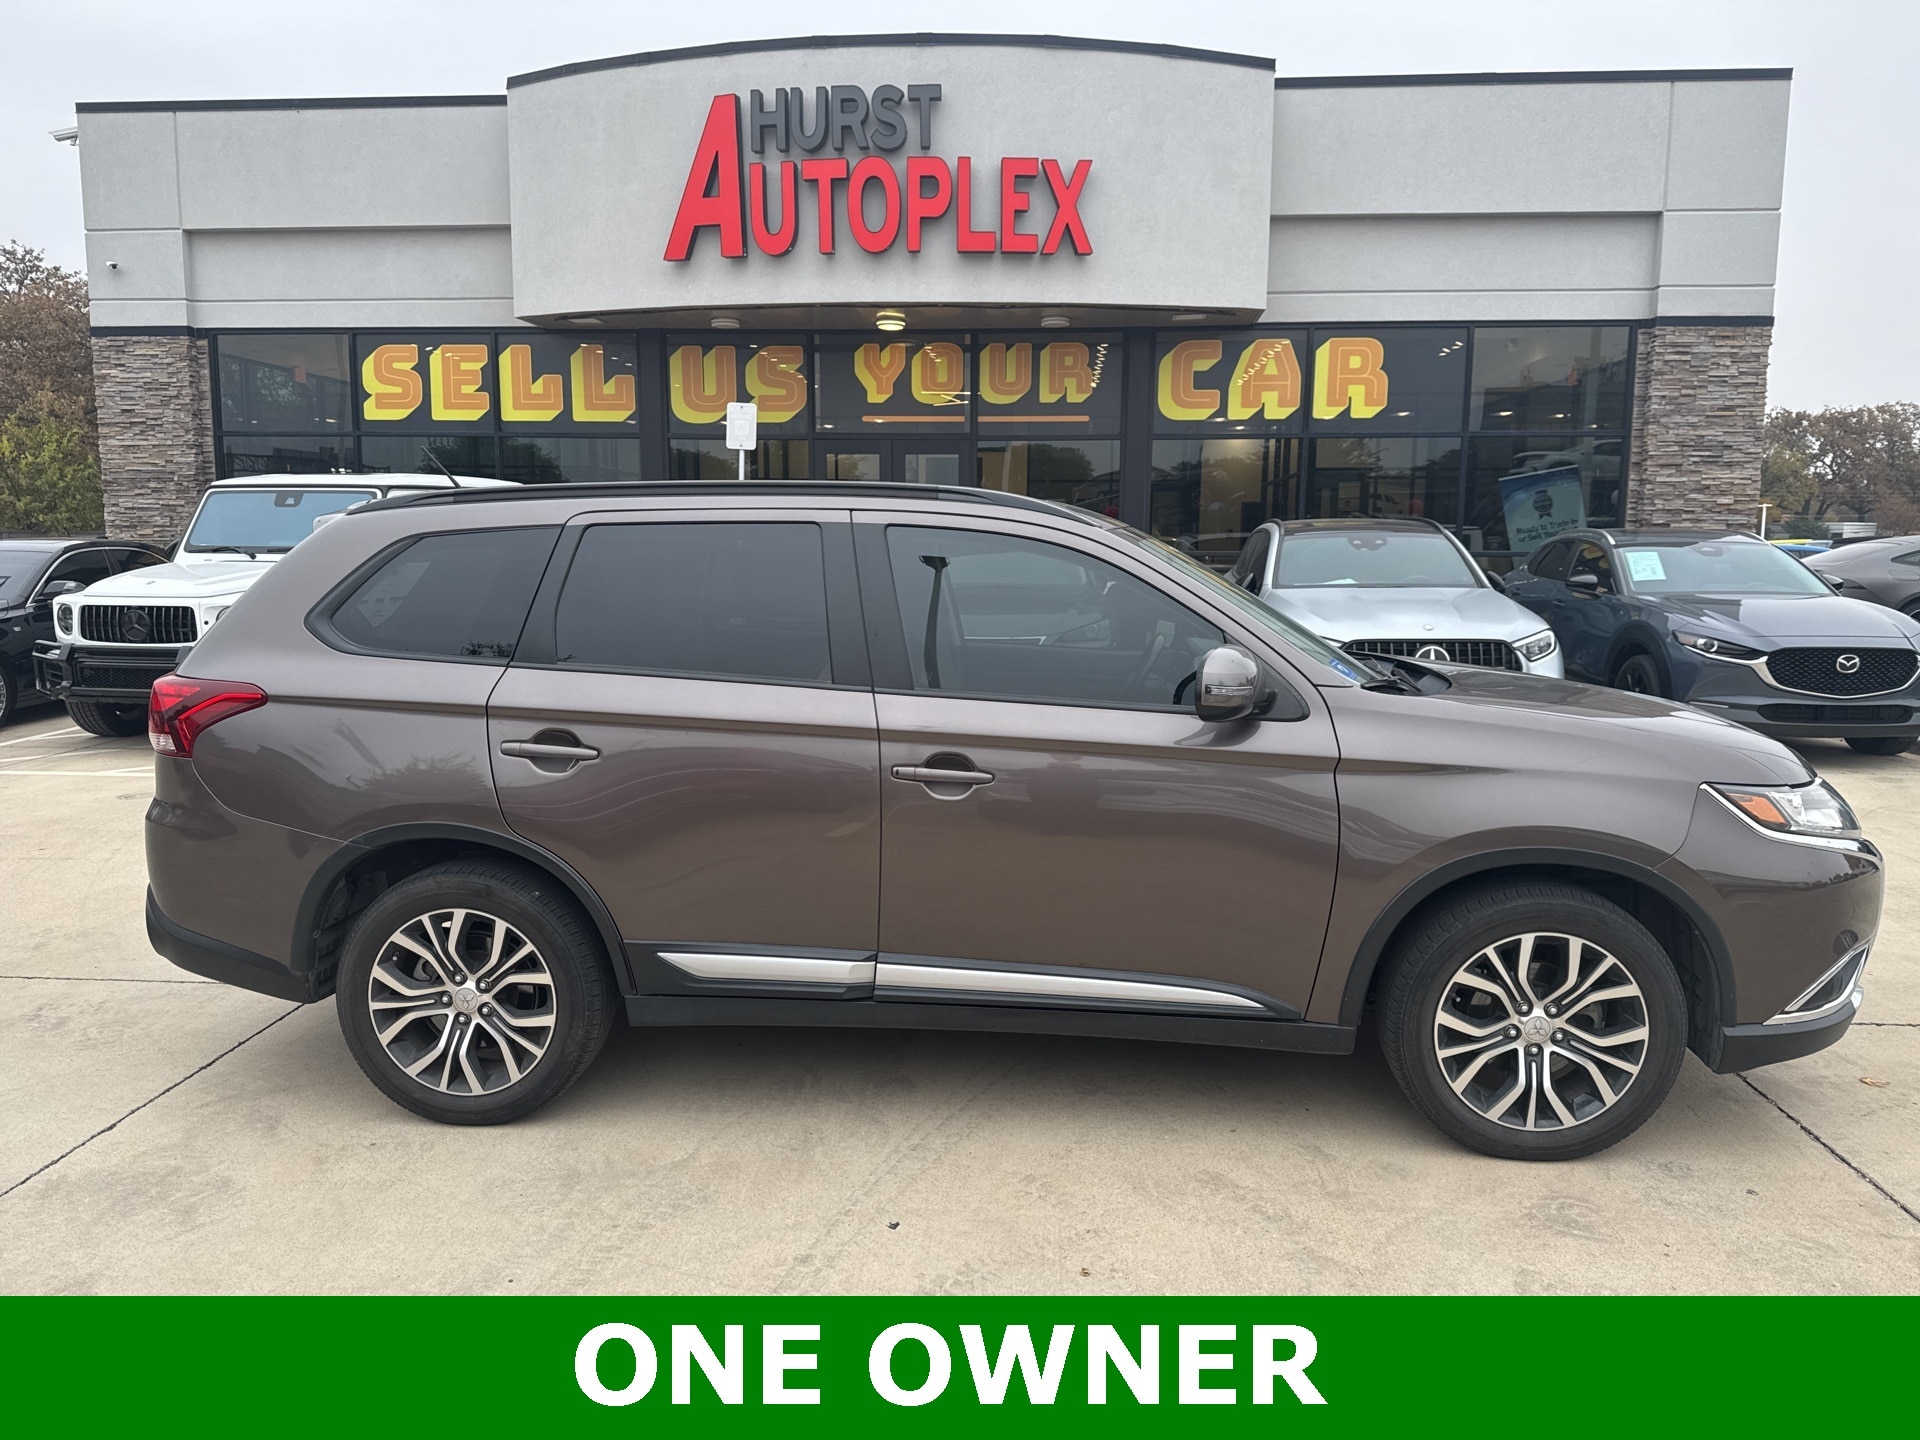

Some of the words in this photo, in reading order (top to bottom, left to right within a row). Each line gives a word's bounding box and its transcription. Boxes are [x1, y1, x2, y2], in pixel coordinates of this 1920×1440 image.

[749, 83, 942, 154] HURST
[663, 93, 1093, 261] AUTOPLEX
[361, 344, 636, 422] SELL
[669, 345, 808, 424] US
[854, 341, 1093, 405] YOUR
[1157, 337, 1389, 421] CAR
[1516, 525, 1538, 535] Ready
[1548, 520, 1569, 529] Trade
[1528, 532, 1543, 542] Sell
